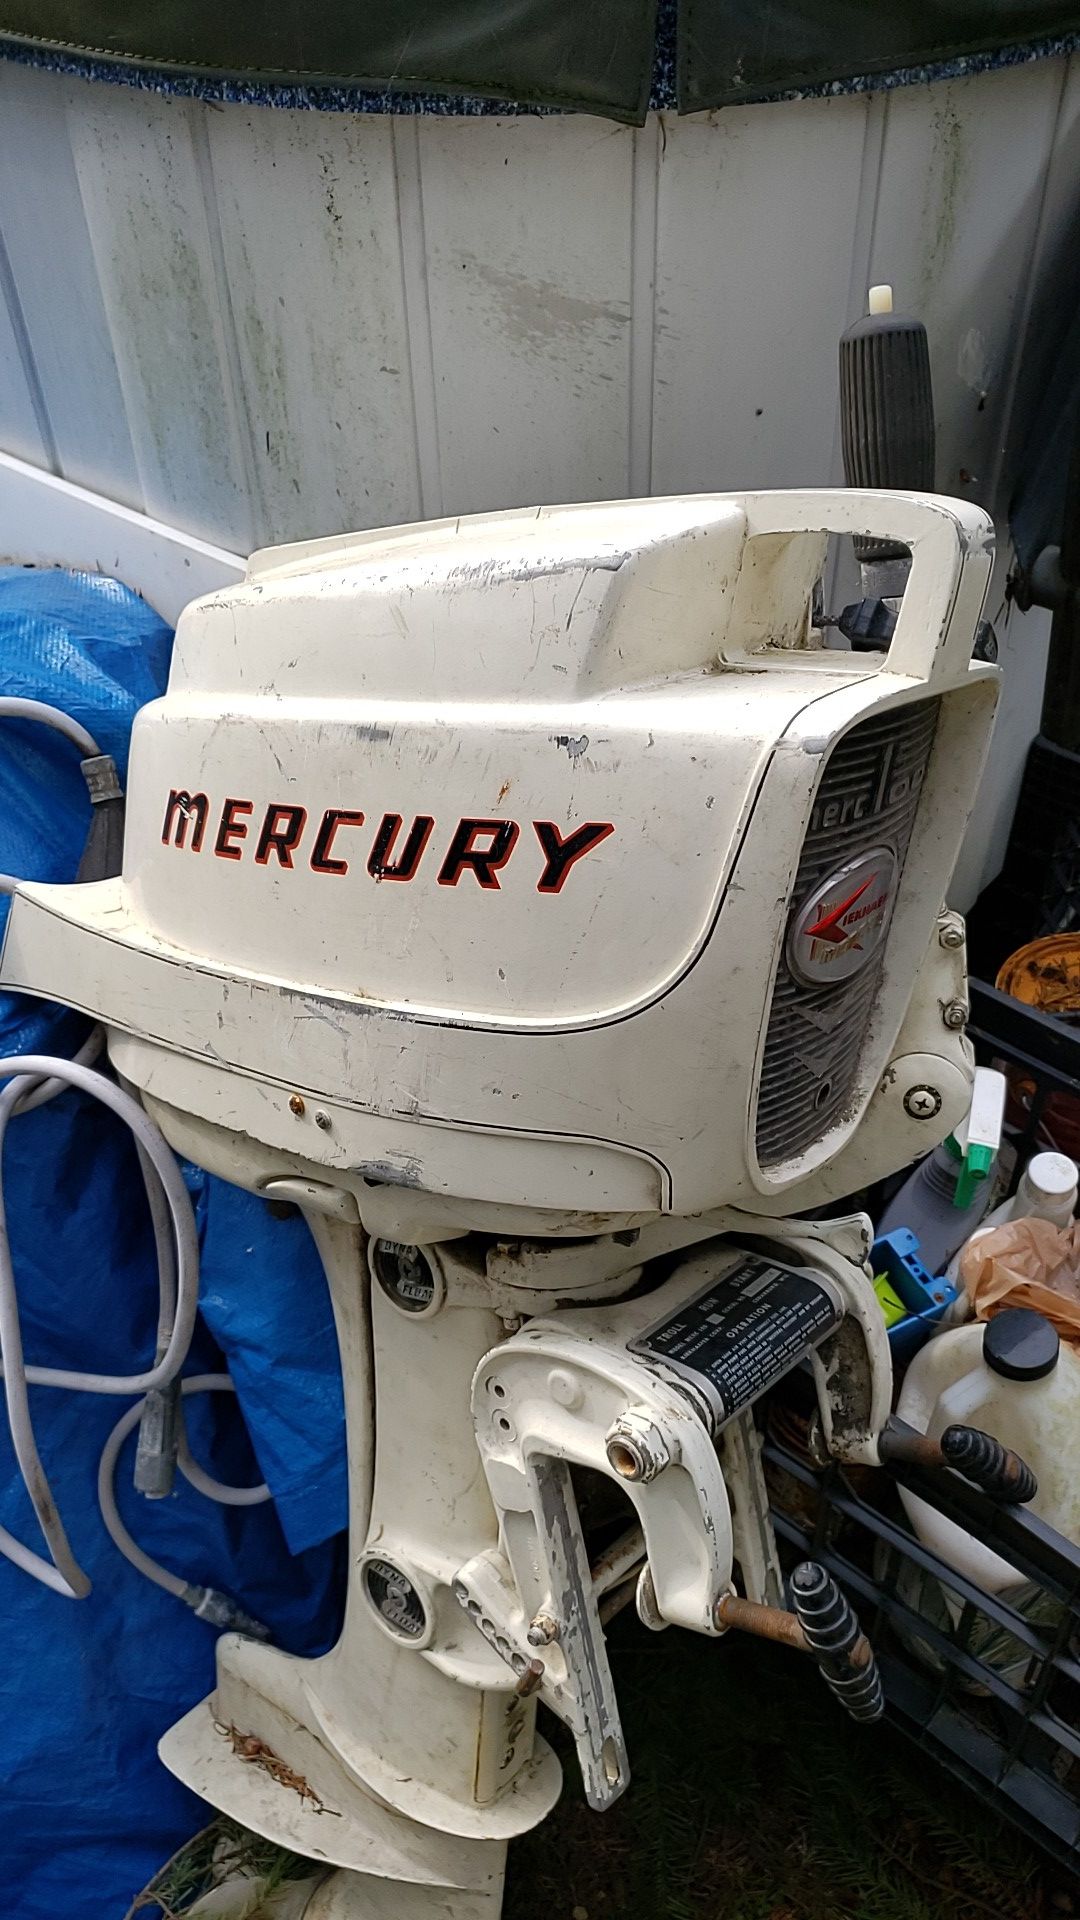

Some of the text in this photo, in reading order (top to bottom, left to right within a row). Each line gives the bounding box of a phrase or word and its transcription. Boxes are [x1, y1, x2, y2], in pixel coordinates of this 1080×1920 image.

[162, 789, 614, 894] MERCURY
[656, 1322, 687, 1343] TROLL
[699, 1297, 720, 1312] RUN
[729, 1268, 757, 1288] START
[726, 1302, 772, 1338] OPERATION
[375, 1562, 406, 1586] DYNA
